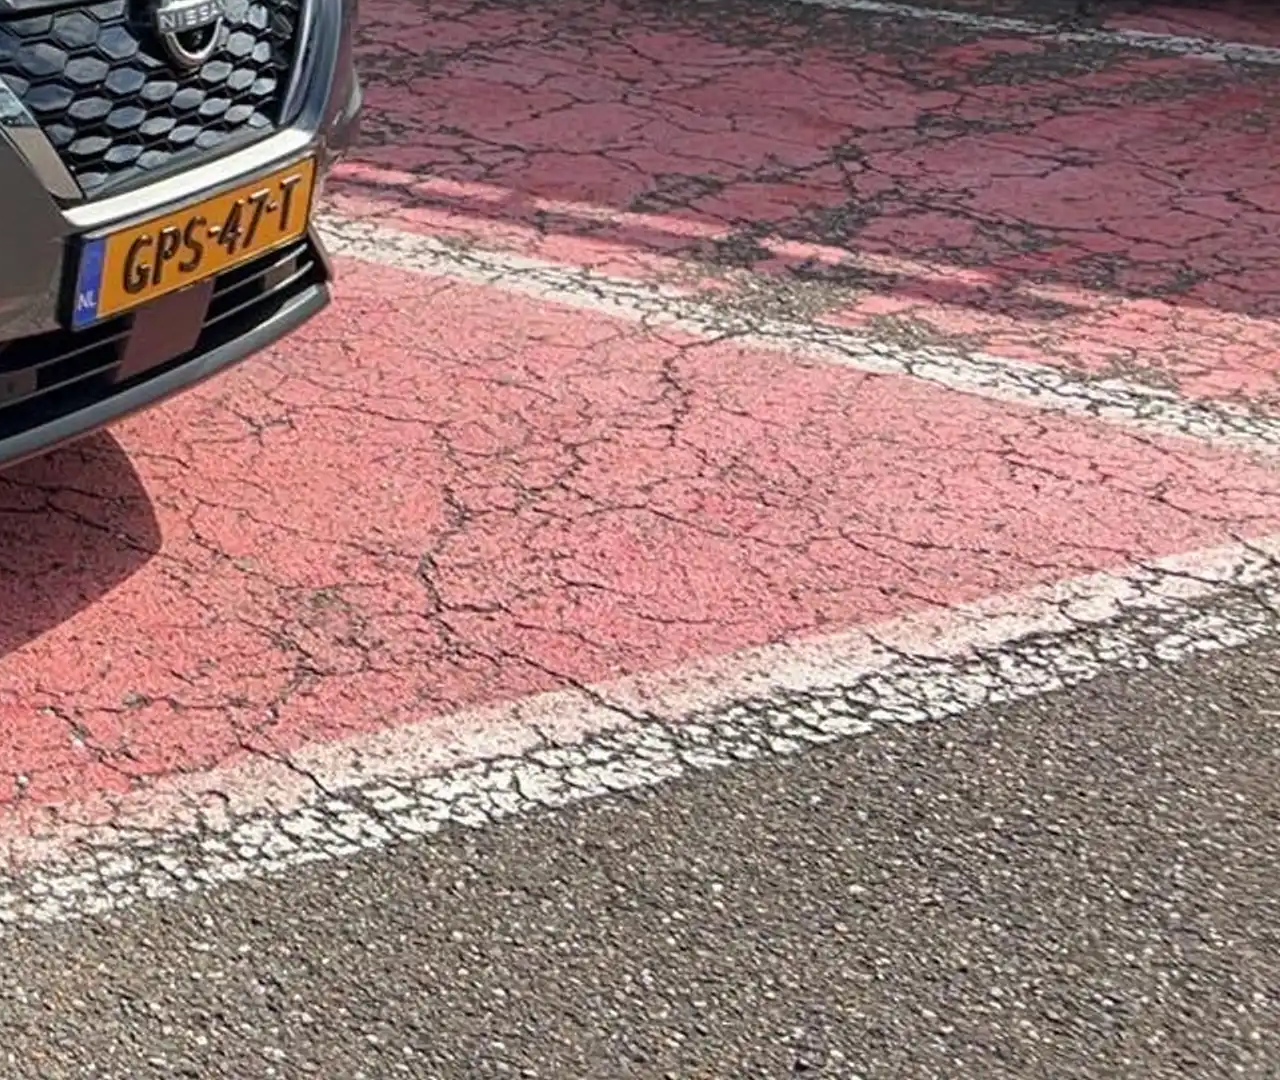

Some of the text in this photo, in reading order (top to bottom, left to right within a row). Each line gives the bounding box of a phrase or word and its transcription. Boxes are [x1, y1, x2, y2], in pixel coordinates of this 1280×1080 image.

[159, 2, 225, 29] NISSA
[123, 174, 303, 295] GPS-47-T
[77, 290, 98, 311] NL
